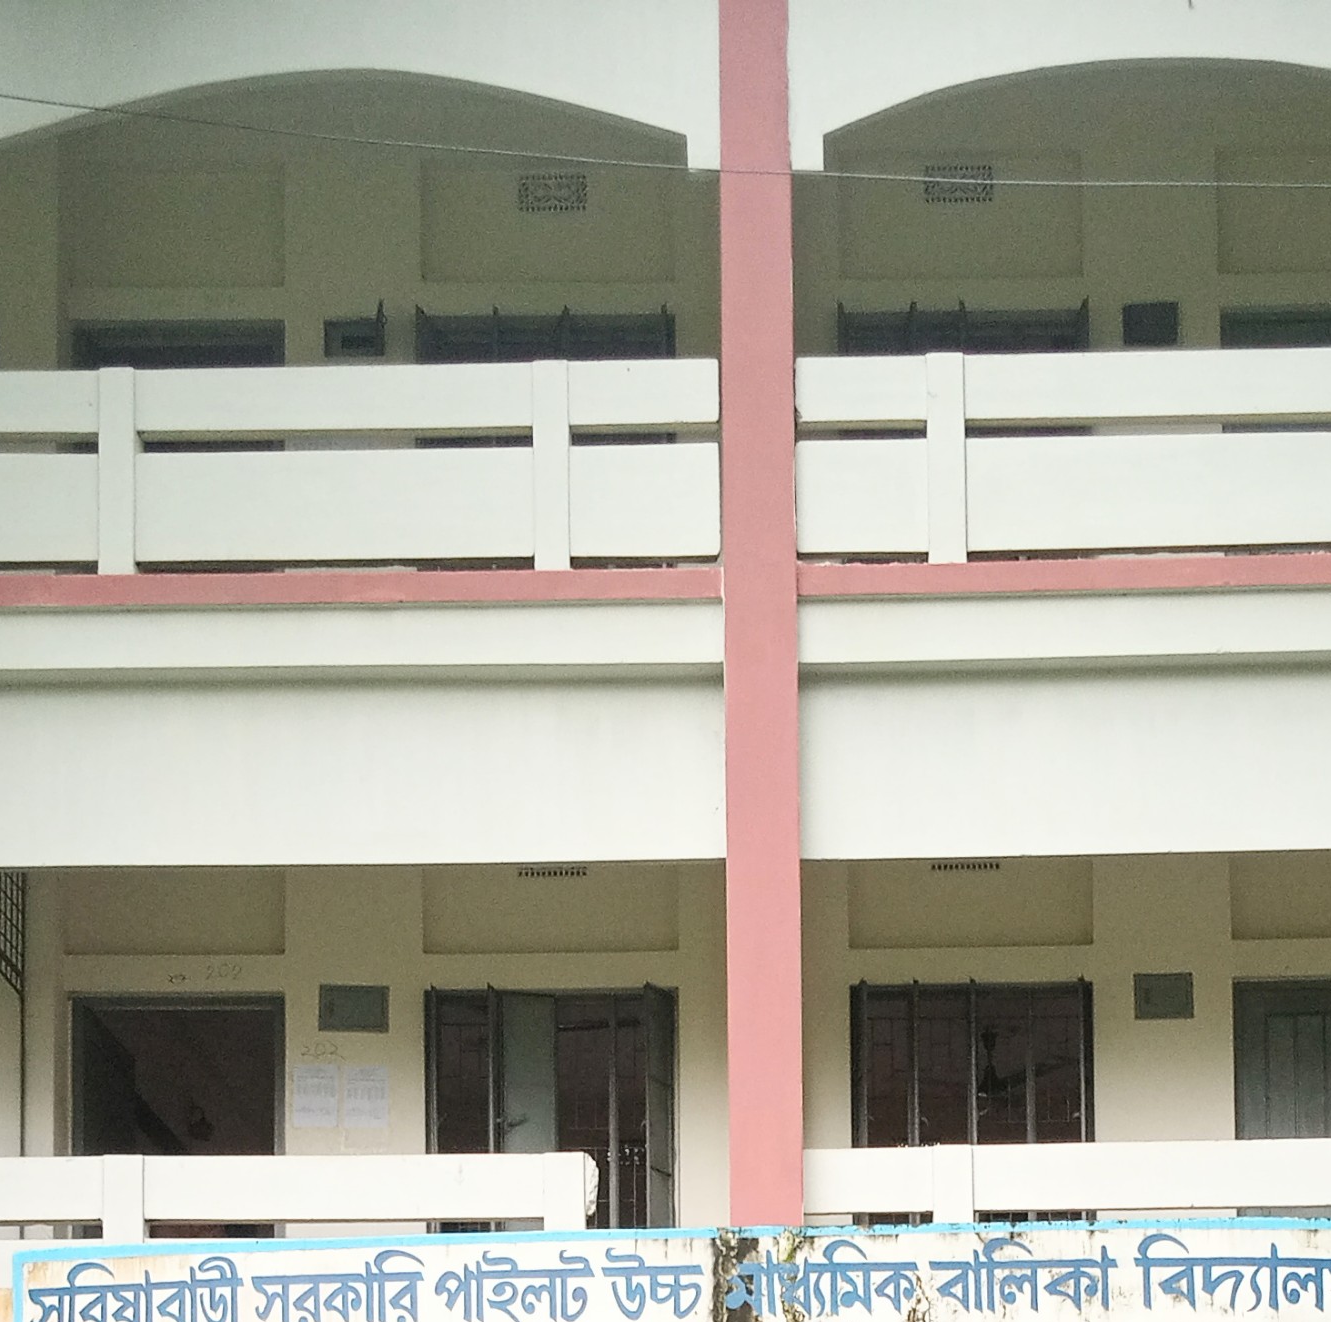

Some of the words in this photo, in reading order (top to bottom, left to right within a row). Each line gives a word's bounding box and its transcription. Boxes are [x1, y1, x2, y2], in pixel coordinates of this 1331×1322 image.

[601, 1247, 703, 1320] উচ্চ
[725, 1239, 920, 1318] মাধ্যমিক
[928, 1236, 1118, 1315] বালিকা
